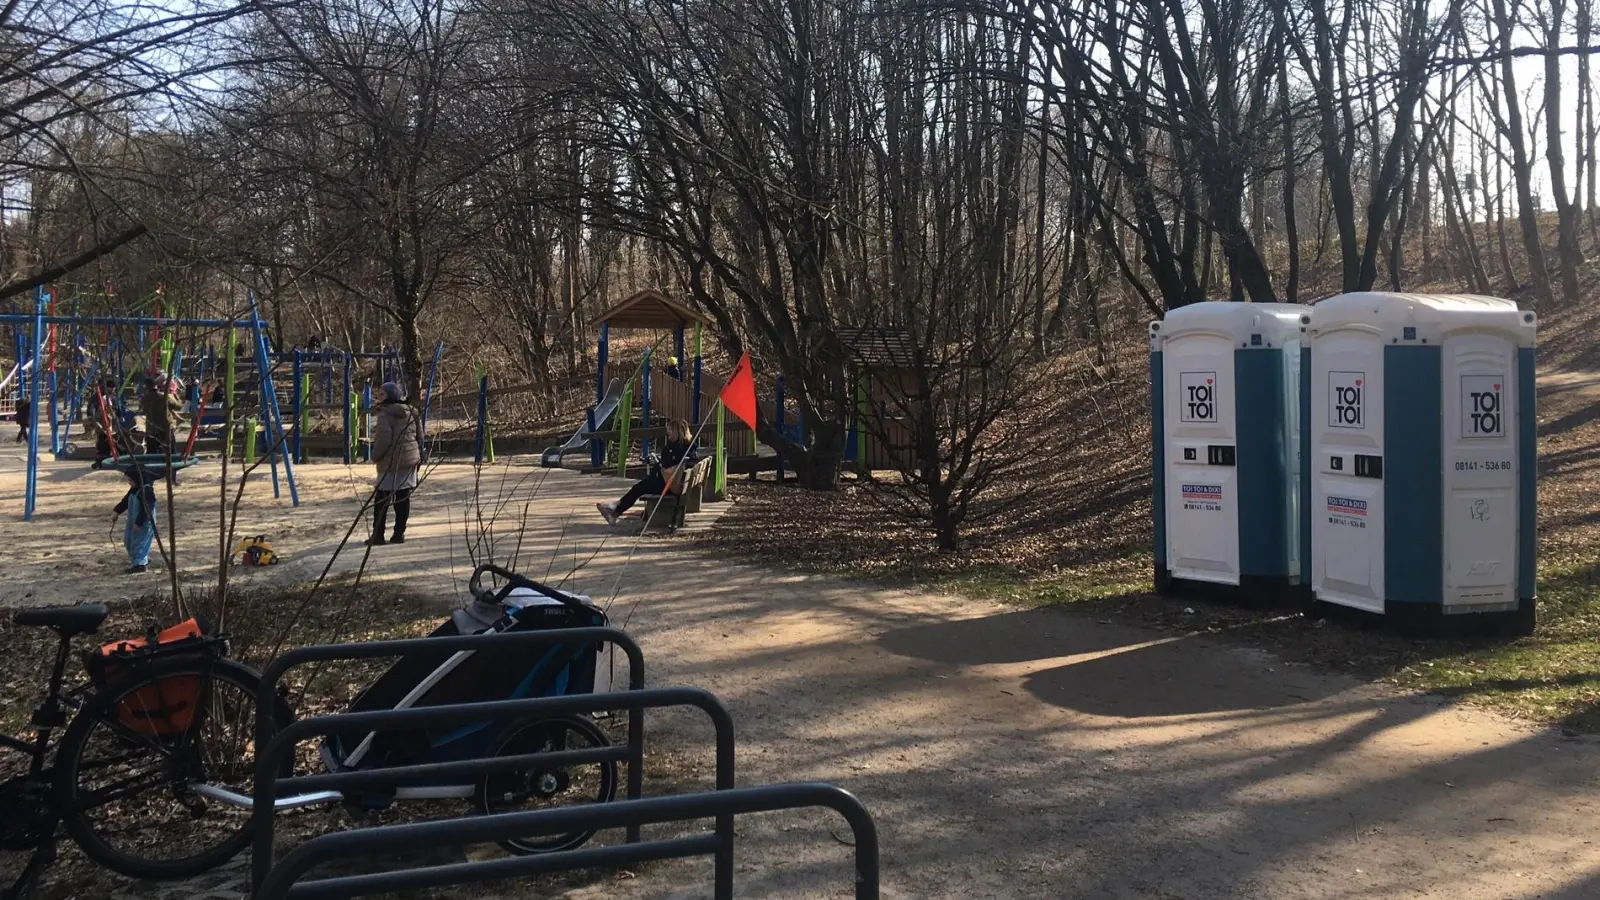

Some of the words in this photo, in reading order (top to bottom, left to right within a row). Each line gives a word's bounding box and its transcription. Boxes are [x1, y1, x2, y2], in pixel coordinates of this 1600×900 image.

[1188, 402, 1213, 419] TOI
[1335, 405, 1361, 424] TOI
[1470, 412, 1501, 434] TOI
[1455, 461, 1478, 471] 08141
[1485, 461, 1500, 471] 536
[1501, 461, 1511, 470] 80
